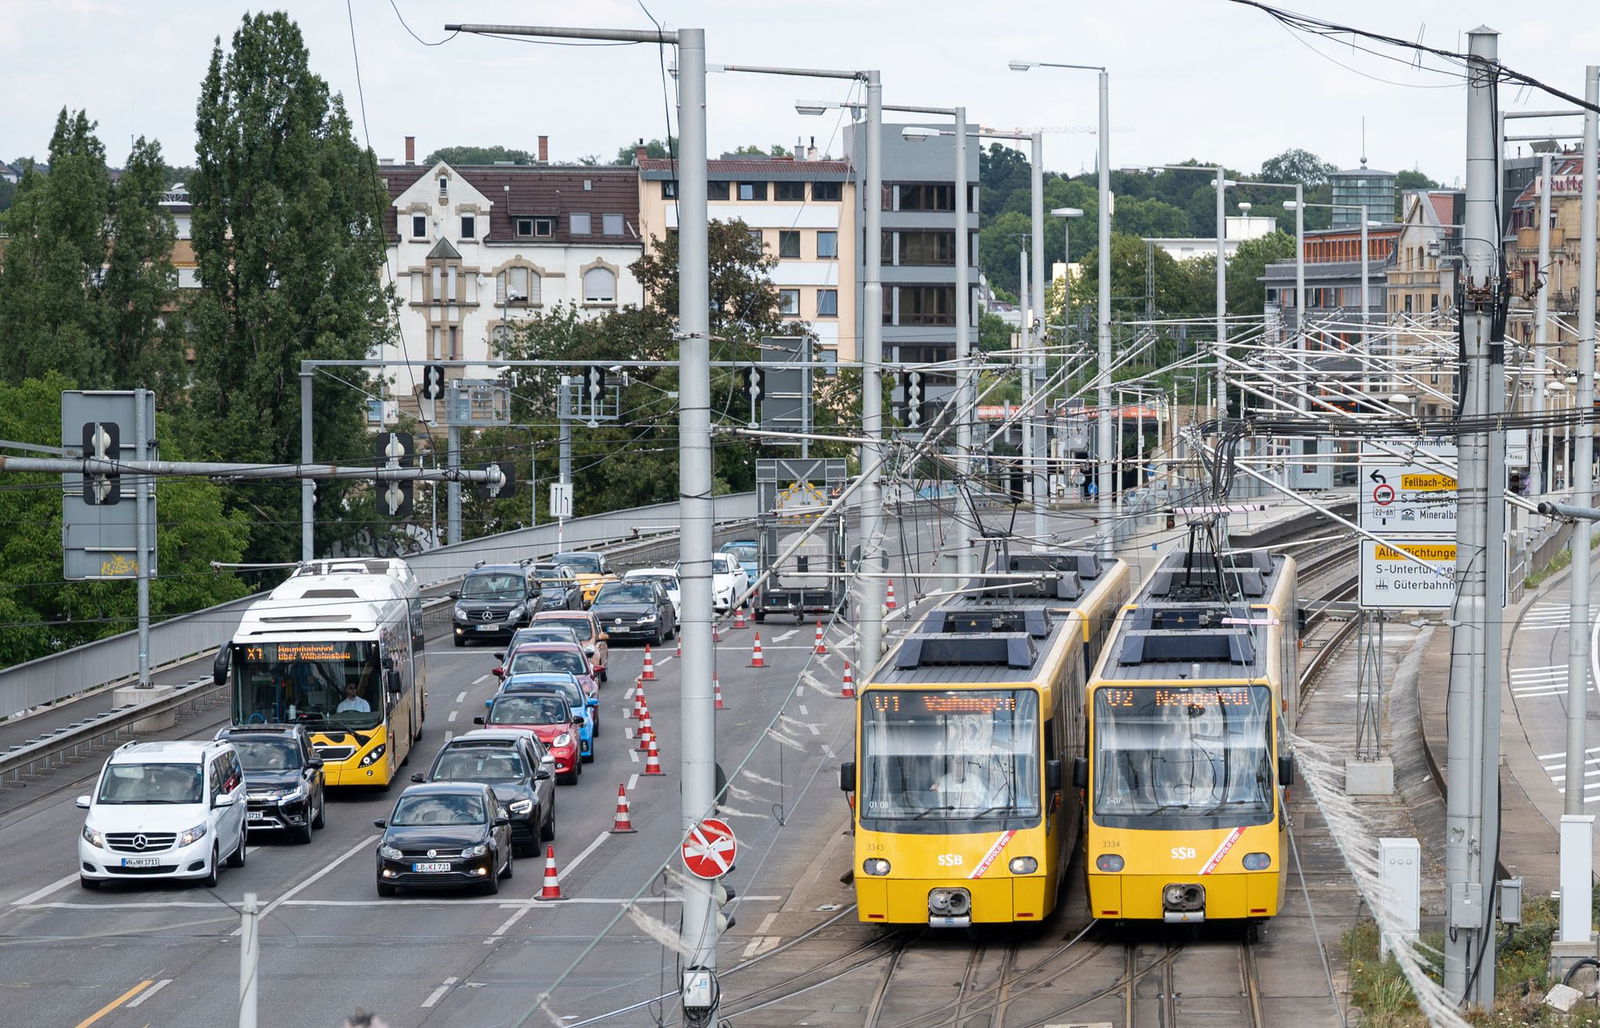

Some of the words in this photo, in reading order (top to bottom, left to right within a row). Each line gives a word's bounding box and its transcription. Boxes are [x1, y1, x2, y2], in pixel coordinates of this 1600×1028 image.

[1378, 547, 1398, 558] Alle
[1394, 580, 1455, 590] Güterbahnh
[247, 648, 263, 660] X1
[875, 696, 899, 711] U1
[1107, 691, 1133, 706] U2
[1102, 840, 1120, 849] 3334
[938, 853, 963, 867] SSB
[1170, 847, 1197, 861] SSB
